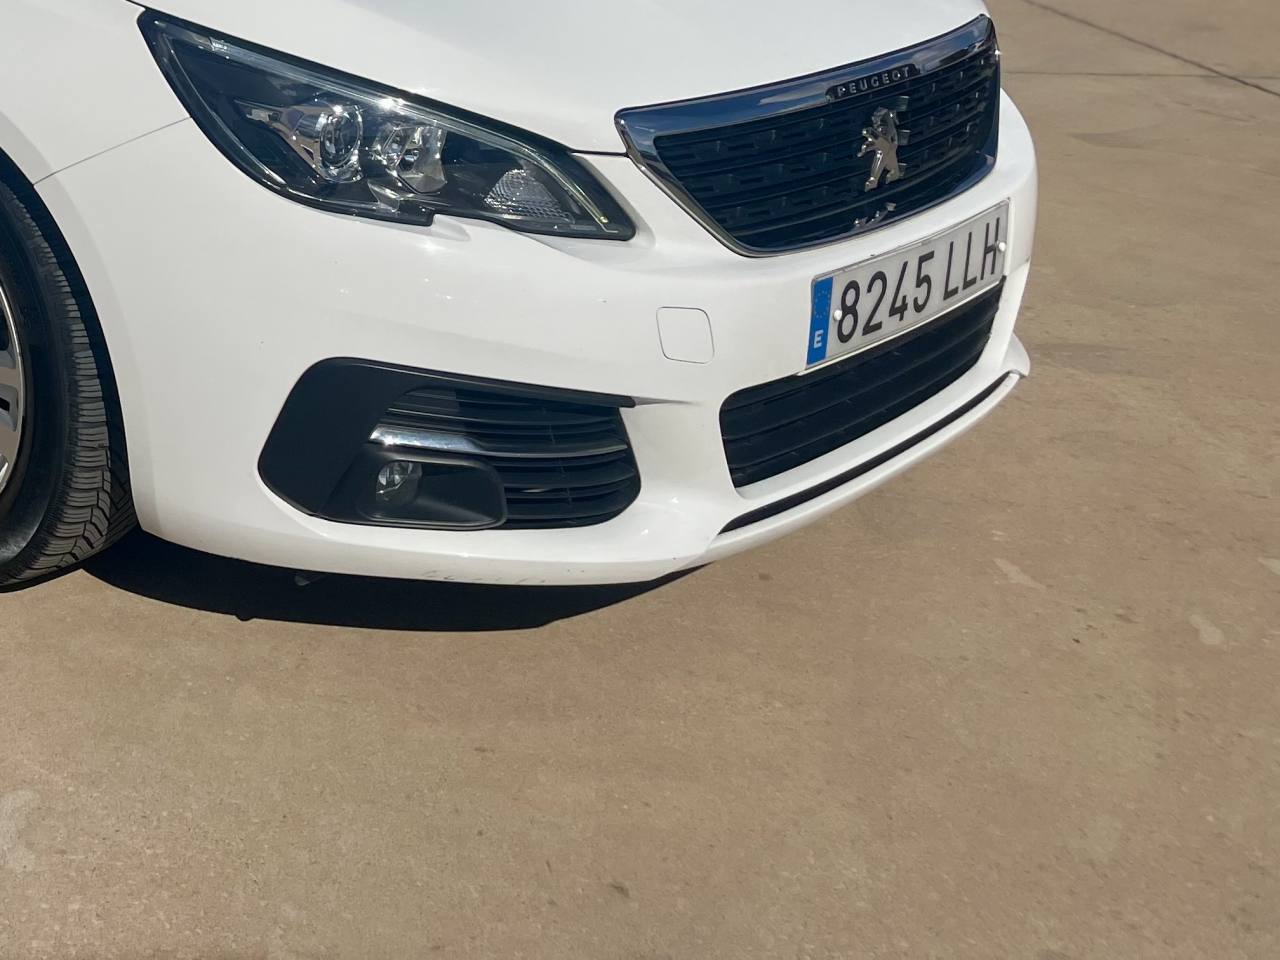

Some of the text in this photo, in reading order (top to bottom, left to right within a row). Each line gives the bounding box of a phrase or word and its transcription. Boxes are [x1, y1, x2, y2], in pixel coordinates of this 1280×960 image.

[837, 67, 909, 96] PEUGEOT
[837, 217, 1000, 344] 8245 LLH
[813, 329, 824, 348] E
